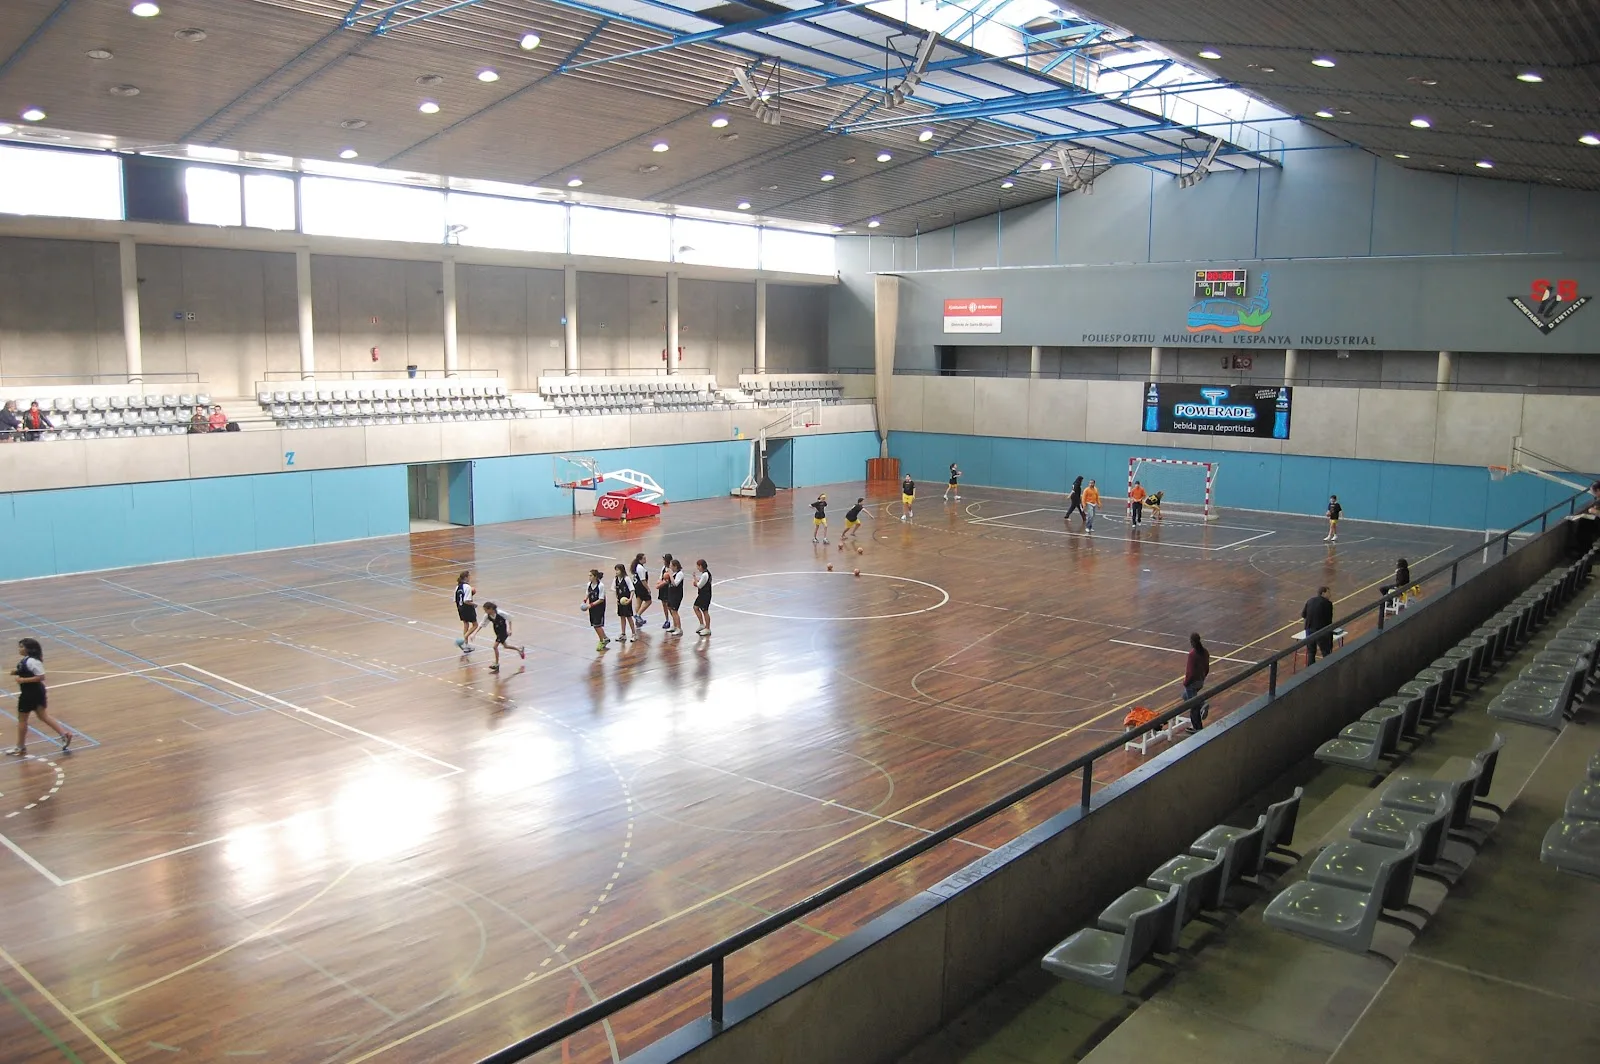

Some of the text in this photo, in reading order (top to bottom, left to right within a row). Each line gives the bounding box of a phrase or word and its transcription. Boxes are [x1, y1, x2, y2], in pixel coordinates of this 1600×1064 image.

[1205, 287, 1211, 295] 0
[1236, 287, 1242, 295] 0
[1512, 298, 1586, 329] SECRETARIAT D'ENTITATS
[1082, 333, 1377, 346] POLIESPORTIU MUNICIPAL L'ESPANYA INDUSTRIAL
[1173, 421, 1255, 434] bebida para deportistas
